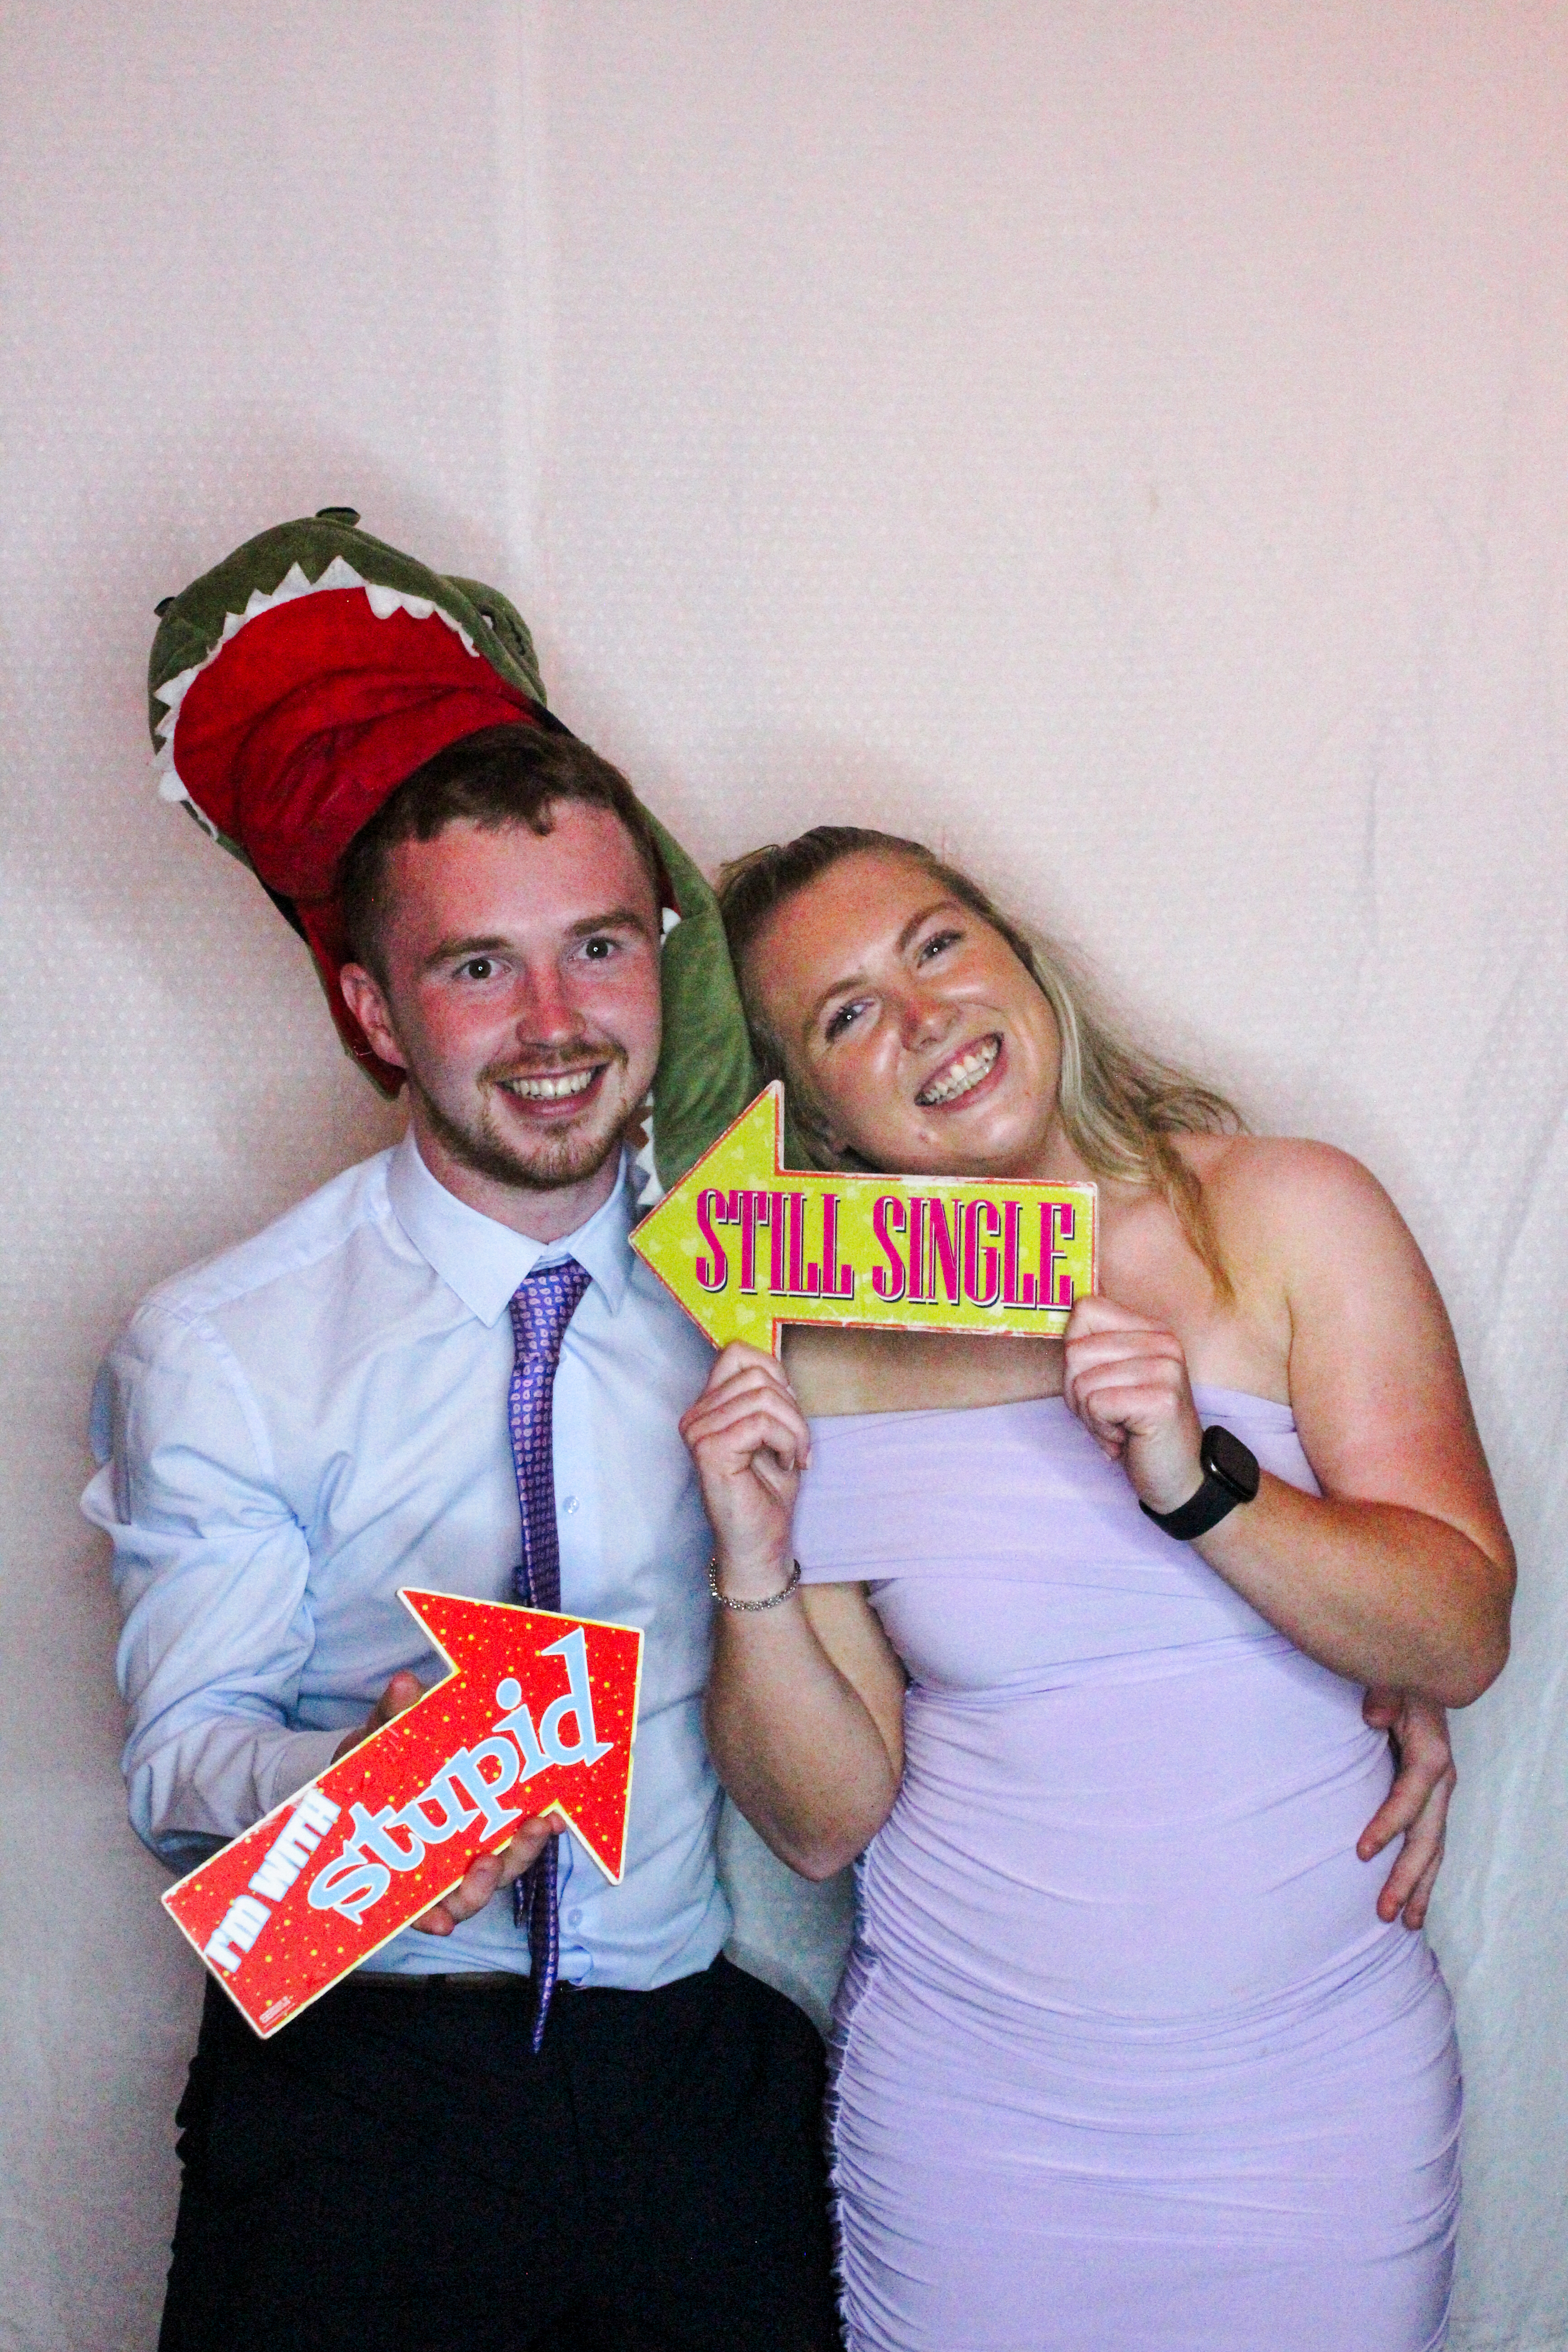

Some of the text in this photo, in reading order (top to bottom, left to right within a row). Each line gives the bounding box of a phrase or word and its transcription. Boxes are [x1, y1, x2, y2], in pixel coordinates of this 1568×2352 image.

[696, 1188, 1075, 1311] STILL SINGLE
[308, 1627, 613, 1925] stupid
[248, 1788, 342, 1901] WITH
